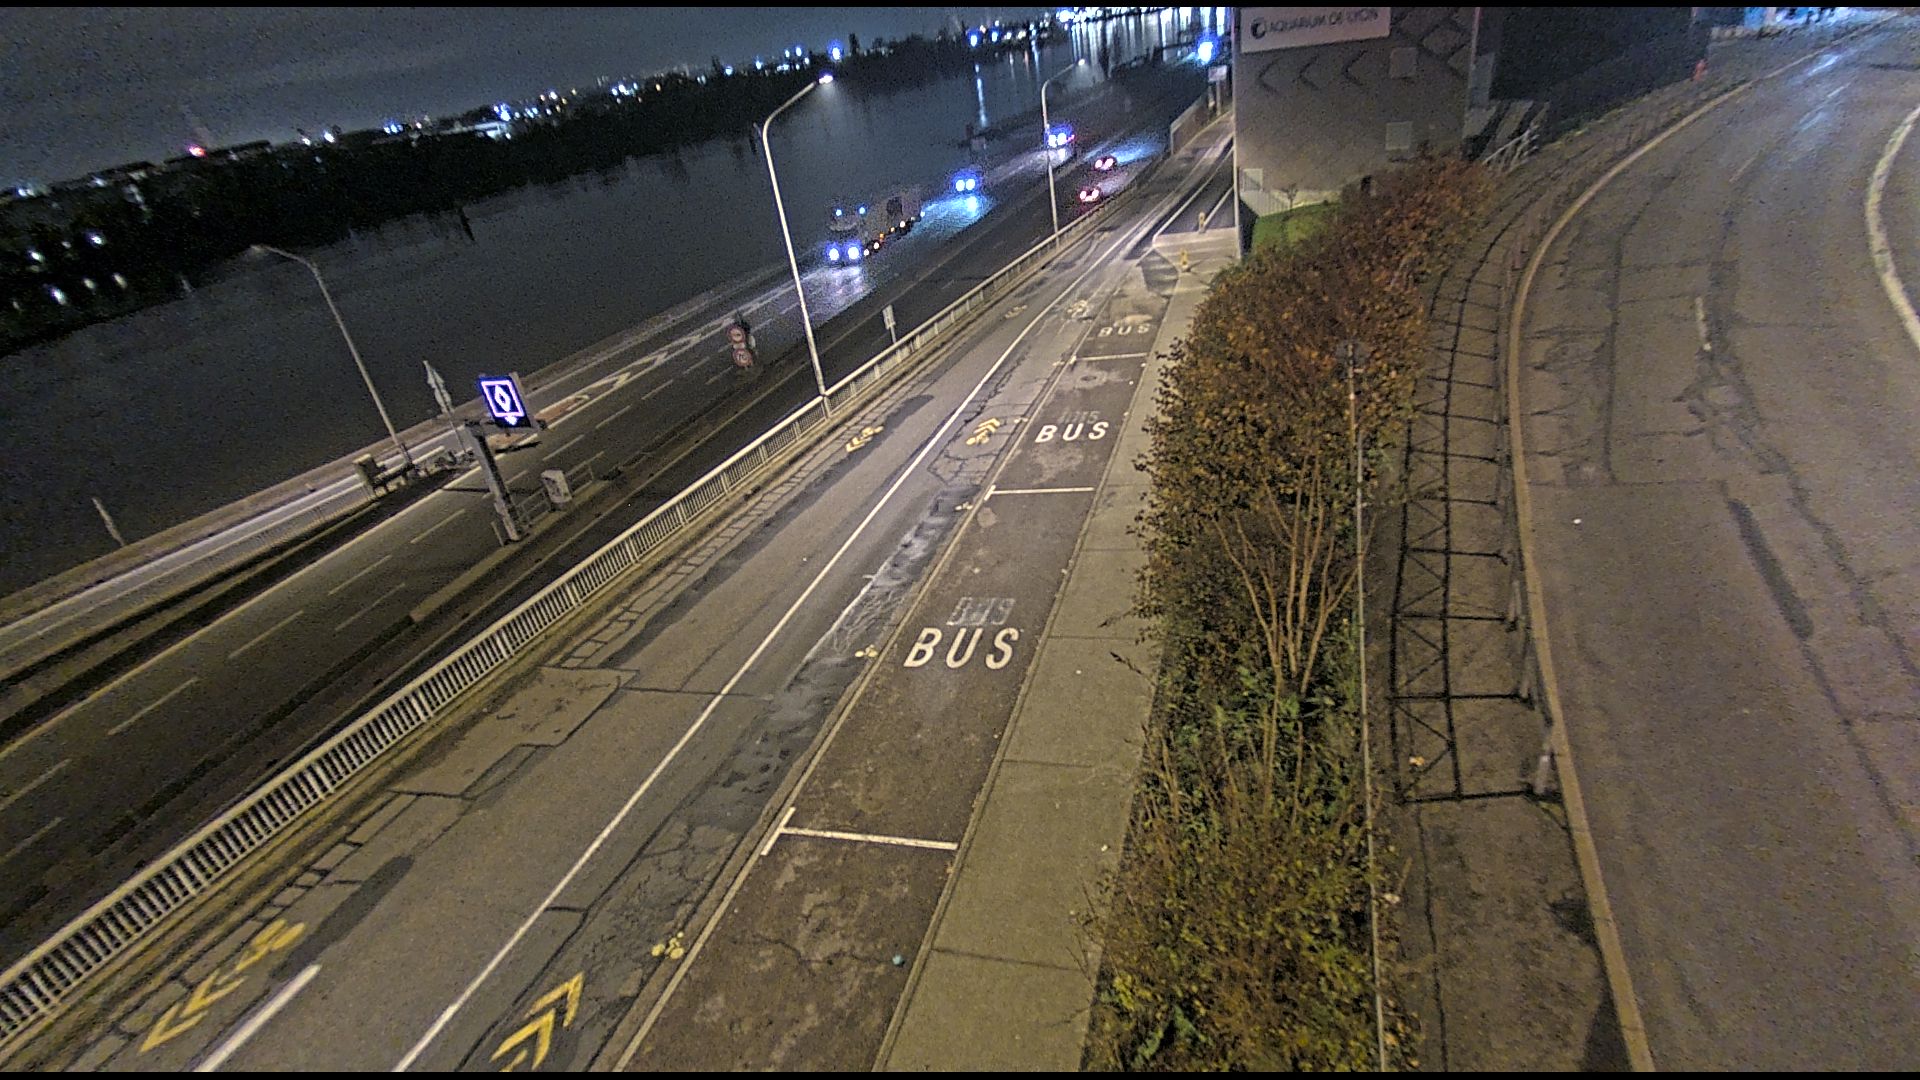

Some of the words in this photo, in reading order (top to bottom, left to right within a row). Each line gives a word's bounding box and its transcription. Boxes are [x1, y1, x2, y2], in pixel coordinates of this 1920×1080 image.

[1098, 324, 1150, 337] BUS
[1034, 421, 1109, 443] BUS
[903, 627, 1019, 669] BUS
